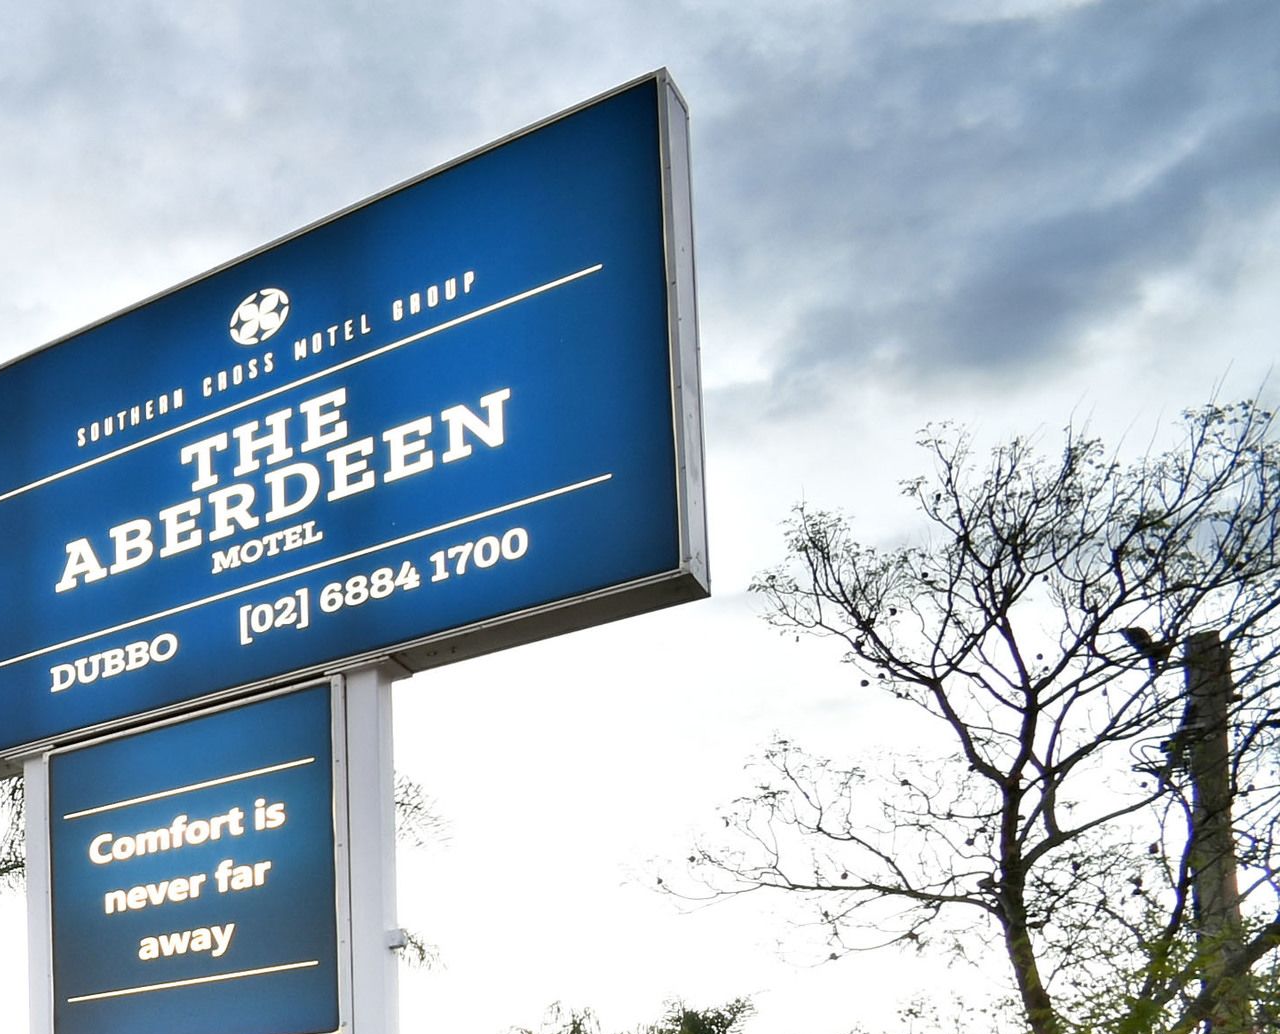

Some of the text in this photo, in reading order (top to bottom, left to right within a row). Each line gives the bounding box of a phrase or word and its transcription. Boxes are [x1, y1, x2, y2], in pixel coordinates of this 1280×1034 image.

[77, 270, 475, 447] SOUTHERN CROSS MOTEL GROUP
[180, 387, 348, 493] THE
[55, 387, 511, 593] ABERDEEN
[211, 520, 323, 574] MOTEL
[239, 527, 529, 646] [02] 6884 1700
[49, 632, 178, 693] DUBBO
[88, 798, 286, 865] Comfort is
[104, 858, 272, 915] never far
[138, 923, 235, 961] away
